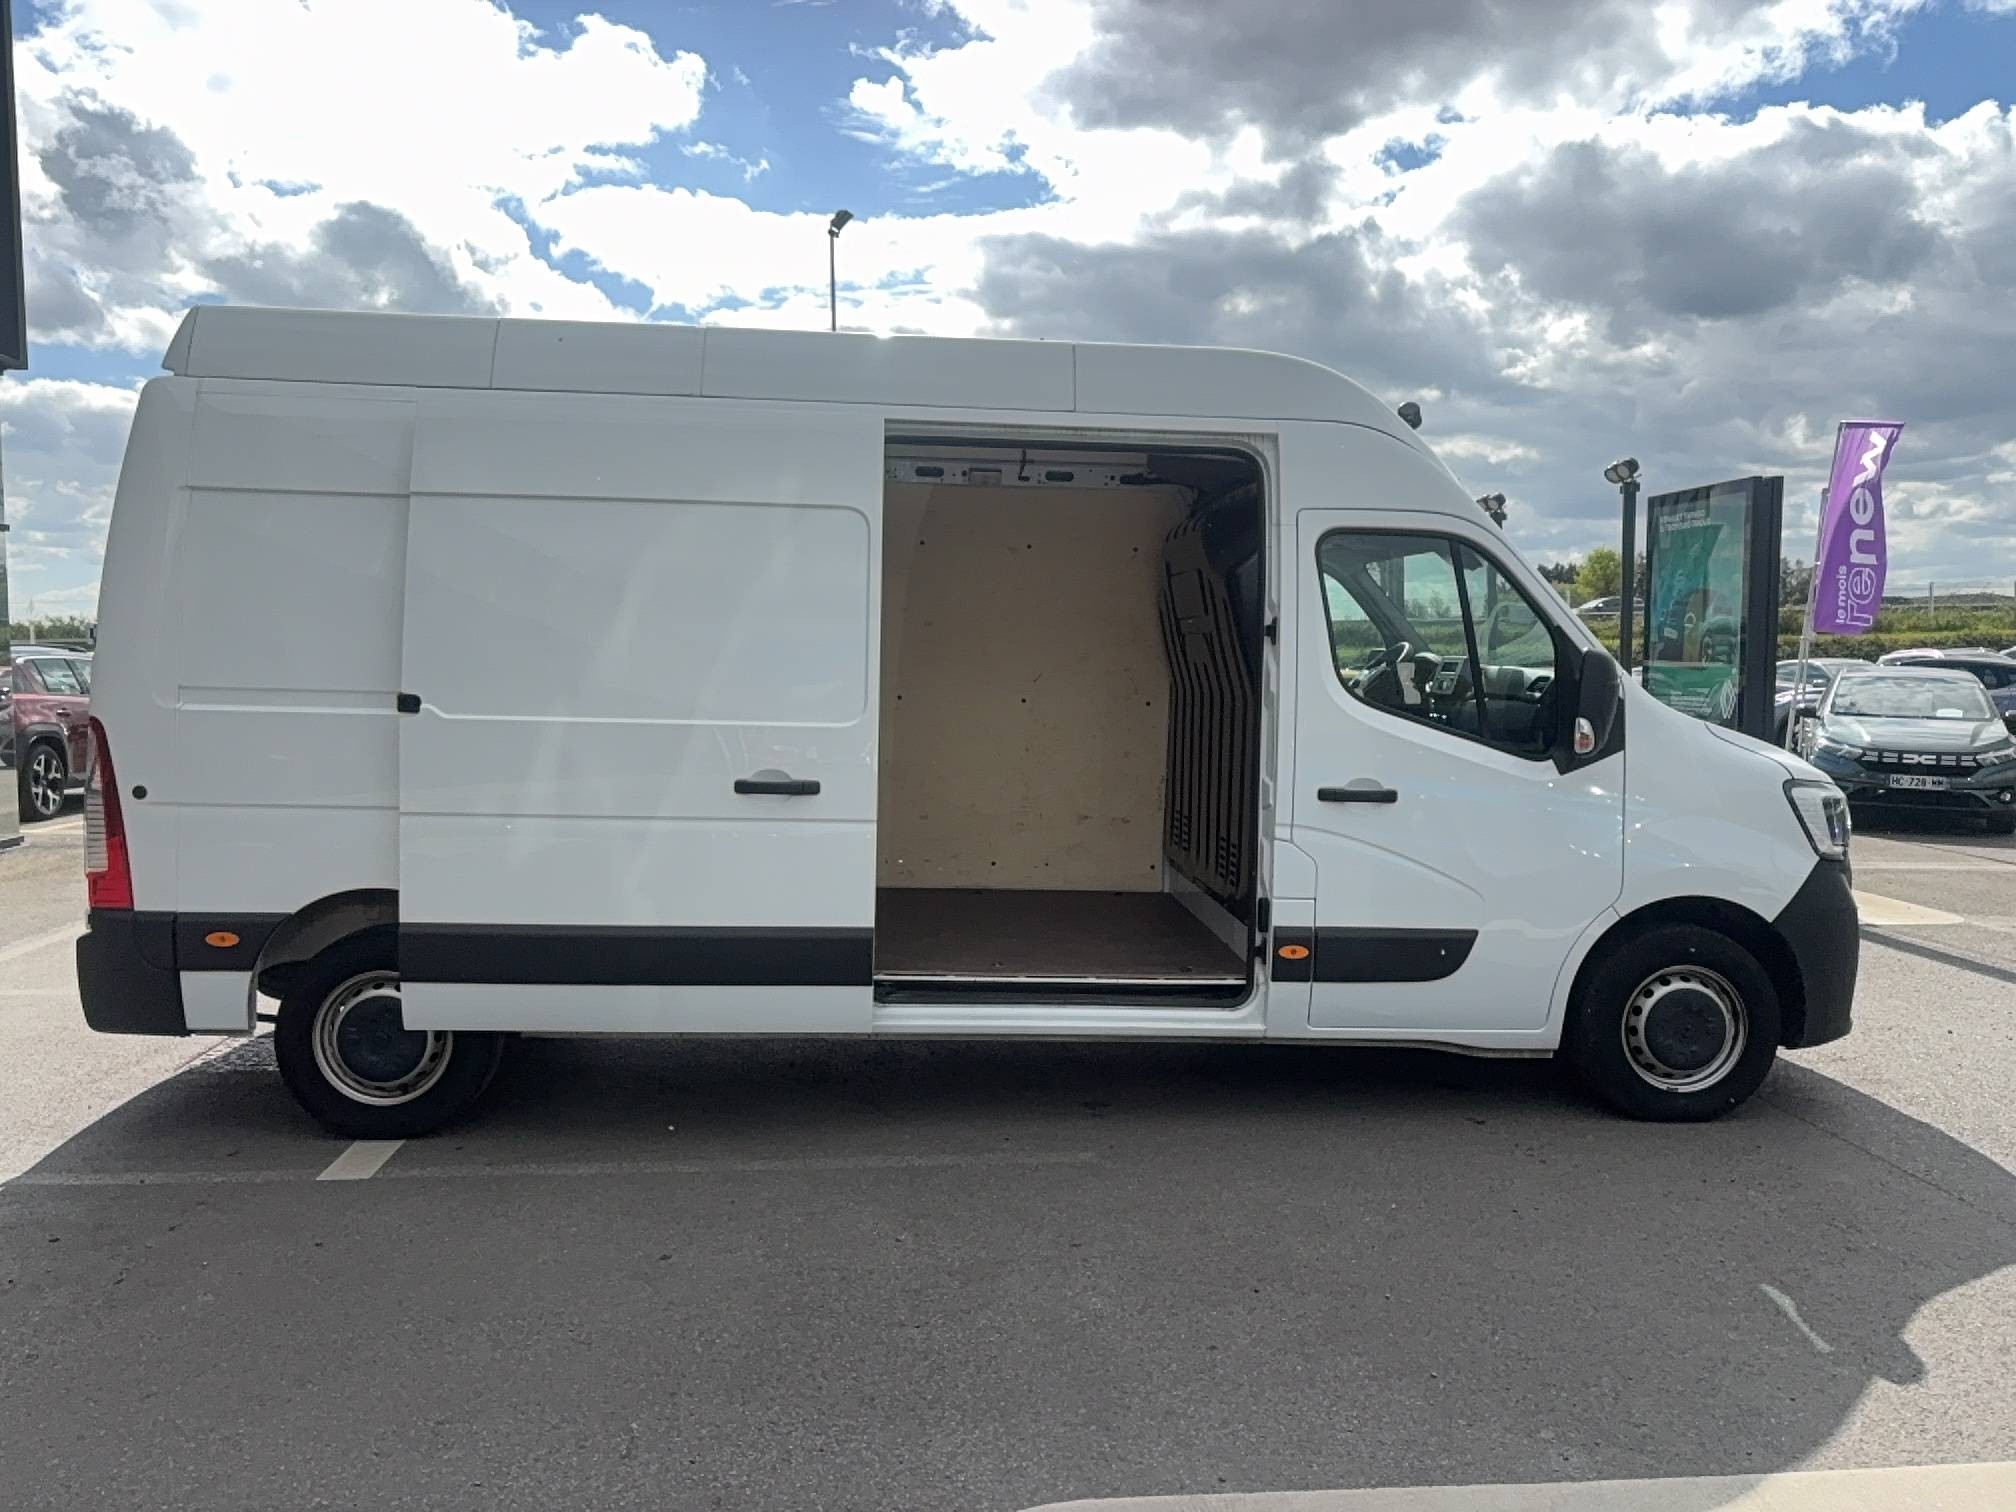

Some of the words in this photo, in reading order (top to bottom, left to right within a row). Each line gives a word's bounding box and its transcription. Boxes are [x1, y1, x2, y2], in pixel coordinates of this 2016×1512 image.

[1846, 431, 1887, 626] renew
[1836, 565, 1847, 606] mois
[1835, 608, 1846, 624] le
